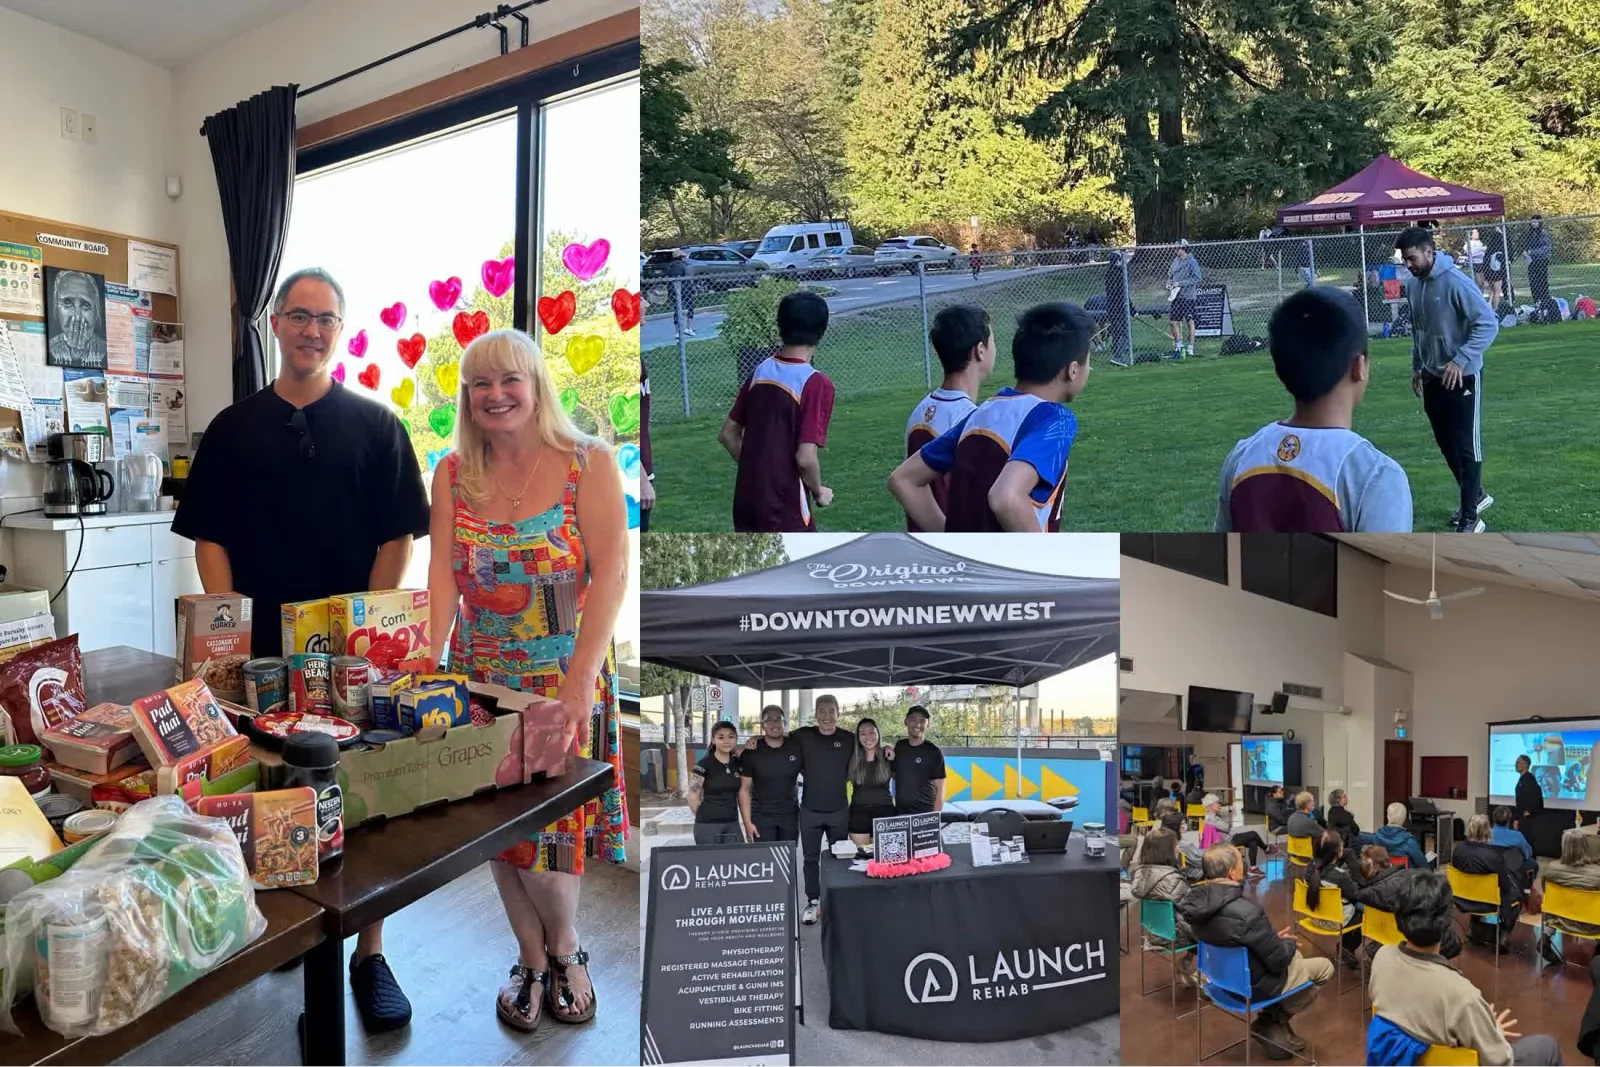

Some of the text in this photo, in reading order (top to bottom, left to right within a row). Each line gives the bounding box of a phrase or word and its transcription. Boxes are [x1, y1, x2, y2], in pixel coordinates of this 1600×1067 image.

[39, 235, 106, 253] COMMUNITY BOARD
[806, 562, 966, 582] The Original
[381, 613, 406, 628] Corn
[739, 601, 1056, 632] #DOWNTOWNNEWWEST
[210, 620, 236, 630] QUAKER
[308, 660, 328, 669] HEINZ
[150, 699, 172, 723] Pad
[208, 706, 216, 714] 3
[73, 722, 94, 736] thai
[158, 712, 180, 736] thai
[438, 740, 493, 766] Grapes
[363, 766, 406, 783] Premium
[226, 808, 250, 828] ad
[296, 830, 304, 840] 3
[696, 862, 774, 880] LAUNCH
[696, 880, 727, 888] REHAB
[691, 903, 786, 917] LIVE A BETTER LIFE
[676, 913, 786, 928] THROUGH MOVEMENT
[722, 946, 784, 956] PHYSIOTHERAPY
[660, 957, 784, 972] REGISTERED MASSAGE THERAPY
[968, 939, 1105, 985] LAUNCH
[691, 969, 784, 982] ACTIVE REHABILITATION
[678, 984, 736, 994] ACUPUNCTURE
[746, 981, 768, 990] GUNN
[973, 984, 1029, 1001] REHAB
[698, 992, 784, 1005] VESTIBULAR THERAPY
[734, 1004, 784, 1014] BIKE FITTING
[690, 1016, 784, 1030] RUNNING ASSESSMENTS
